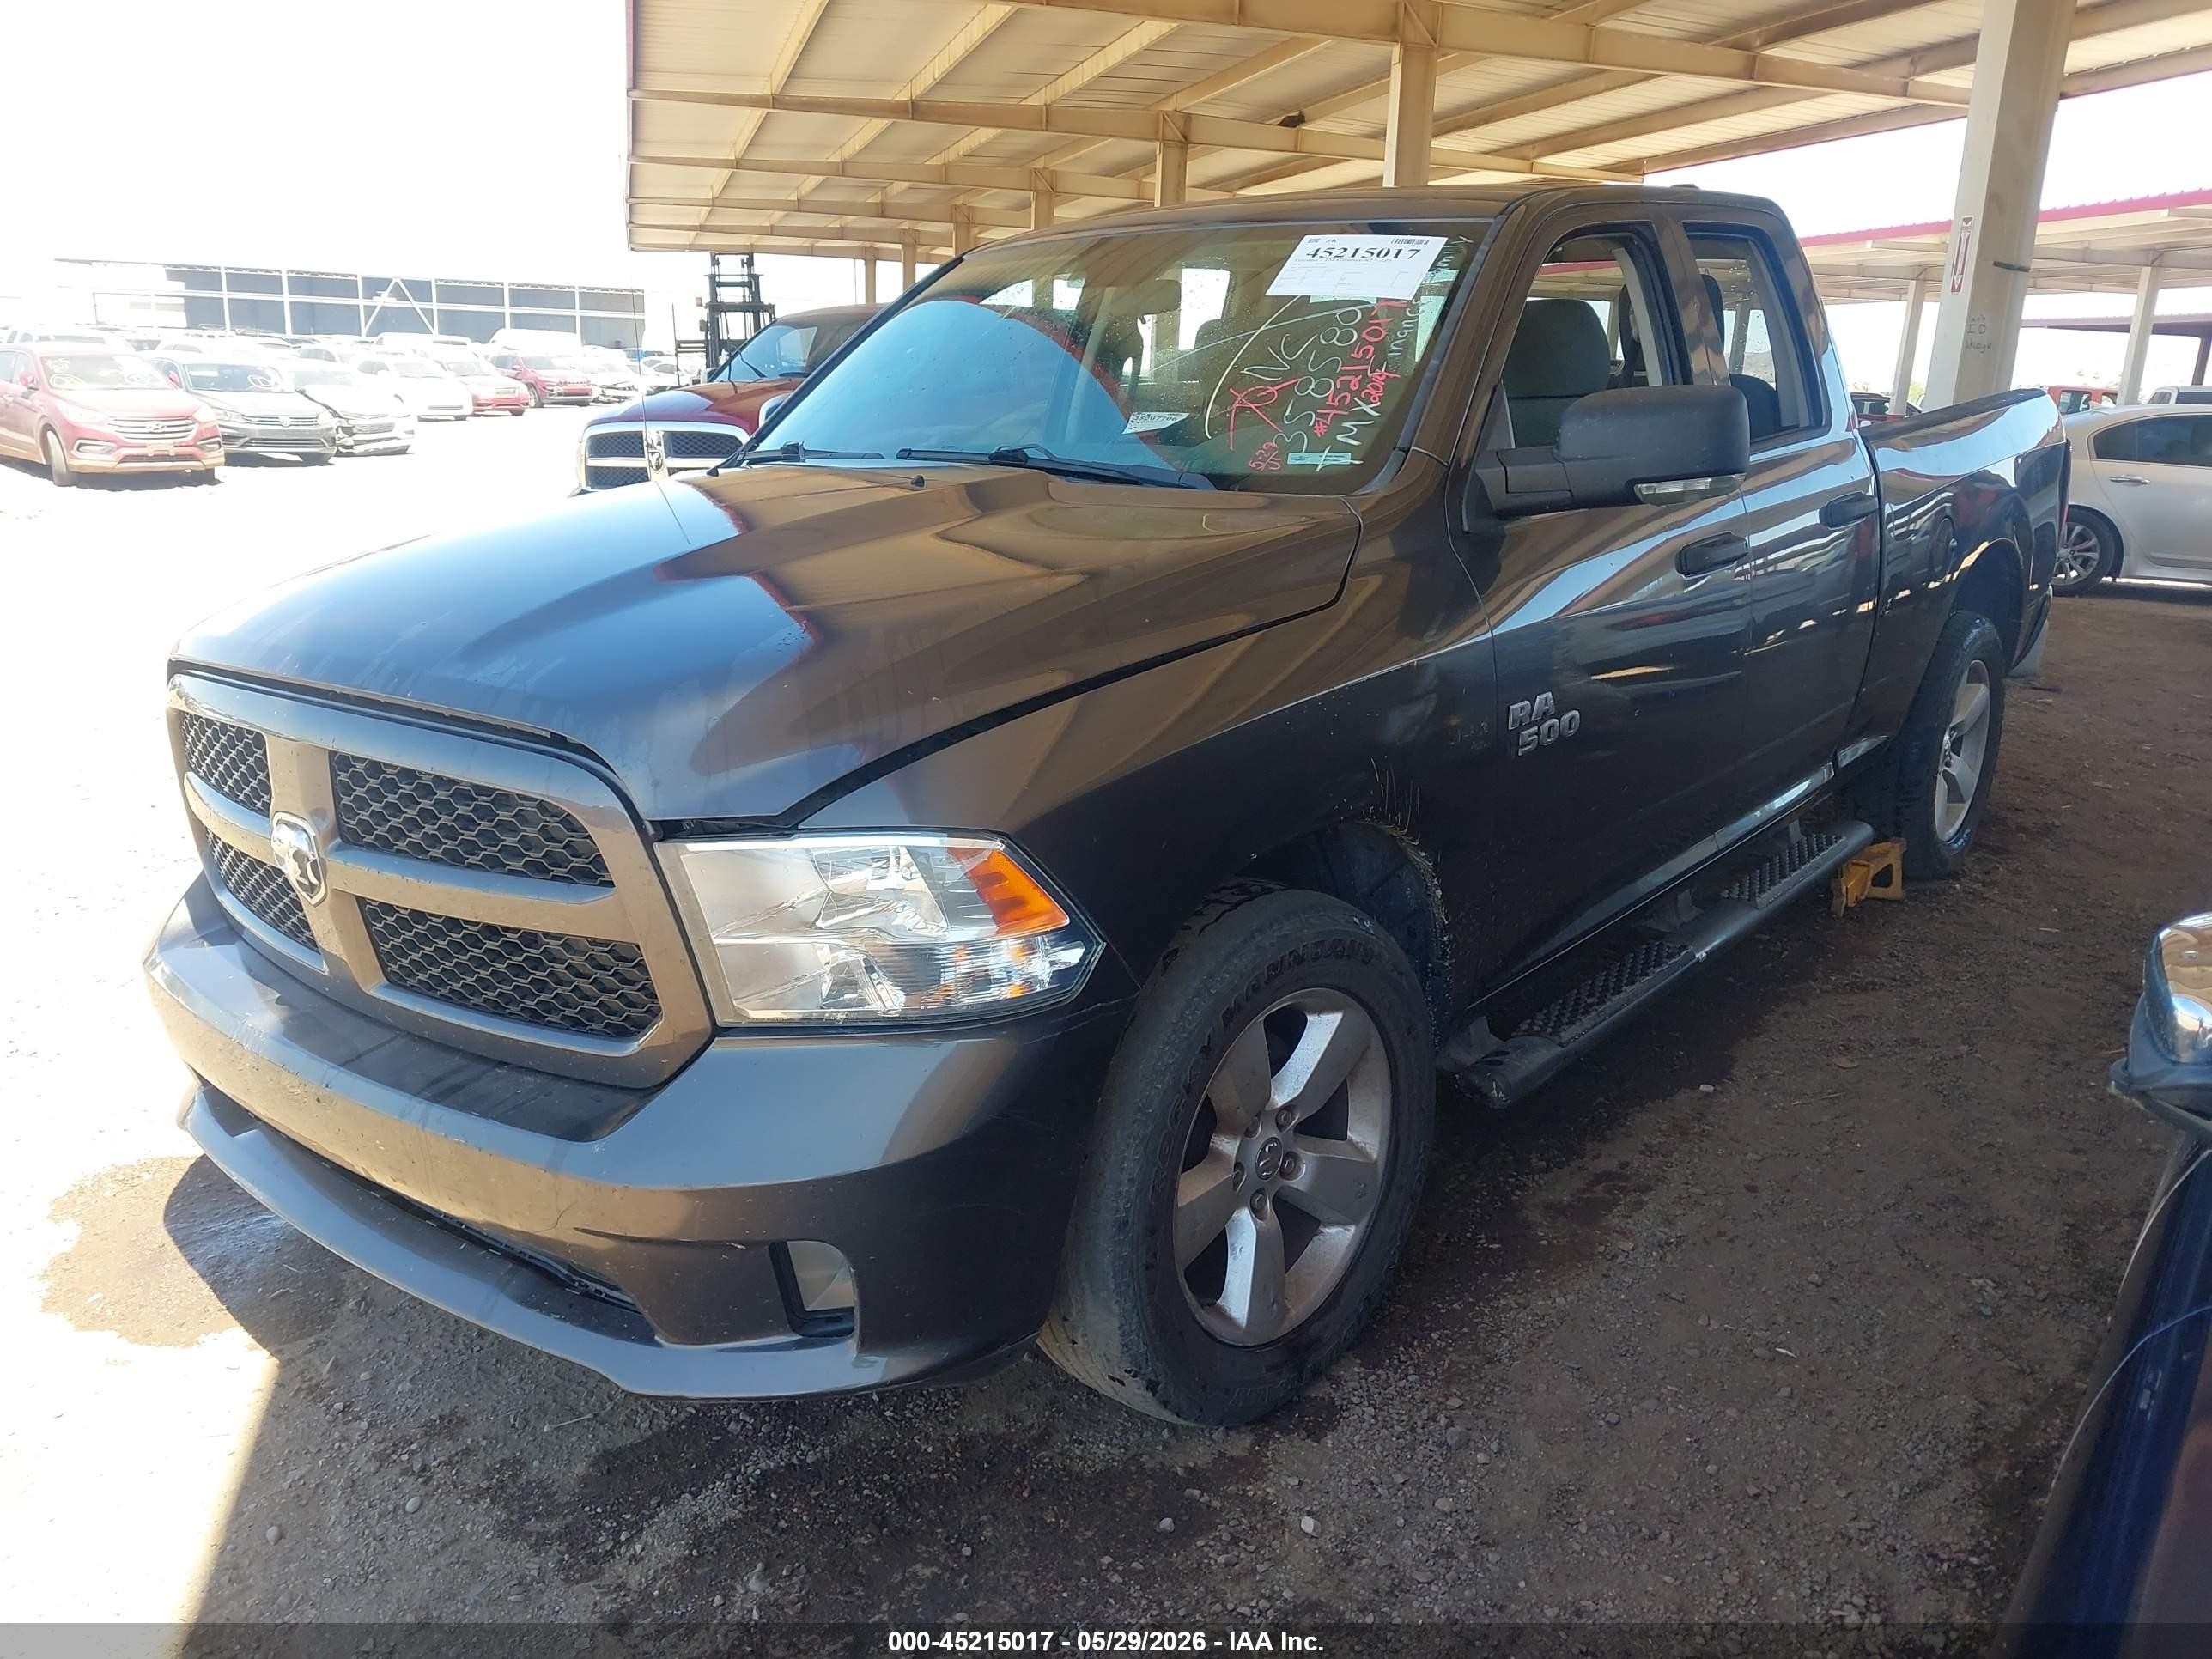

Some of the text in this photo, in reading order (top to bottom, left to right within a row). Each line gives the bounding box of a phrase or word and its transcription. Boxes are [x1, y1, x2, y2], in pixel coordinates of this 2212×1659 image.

[1305, 246, 1422, 261] 45215017
[1314, 300, 1408, 438] #45215017
[1509, 691, 1555, 730] RA
[1518, 710, 1580, 756] 500
